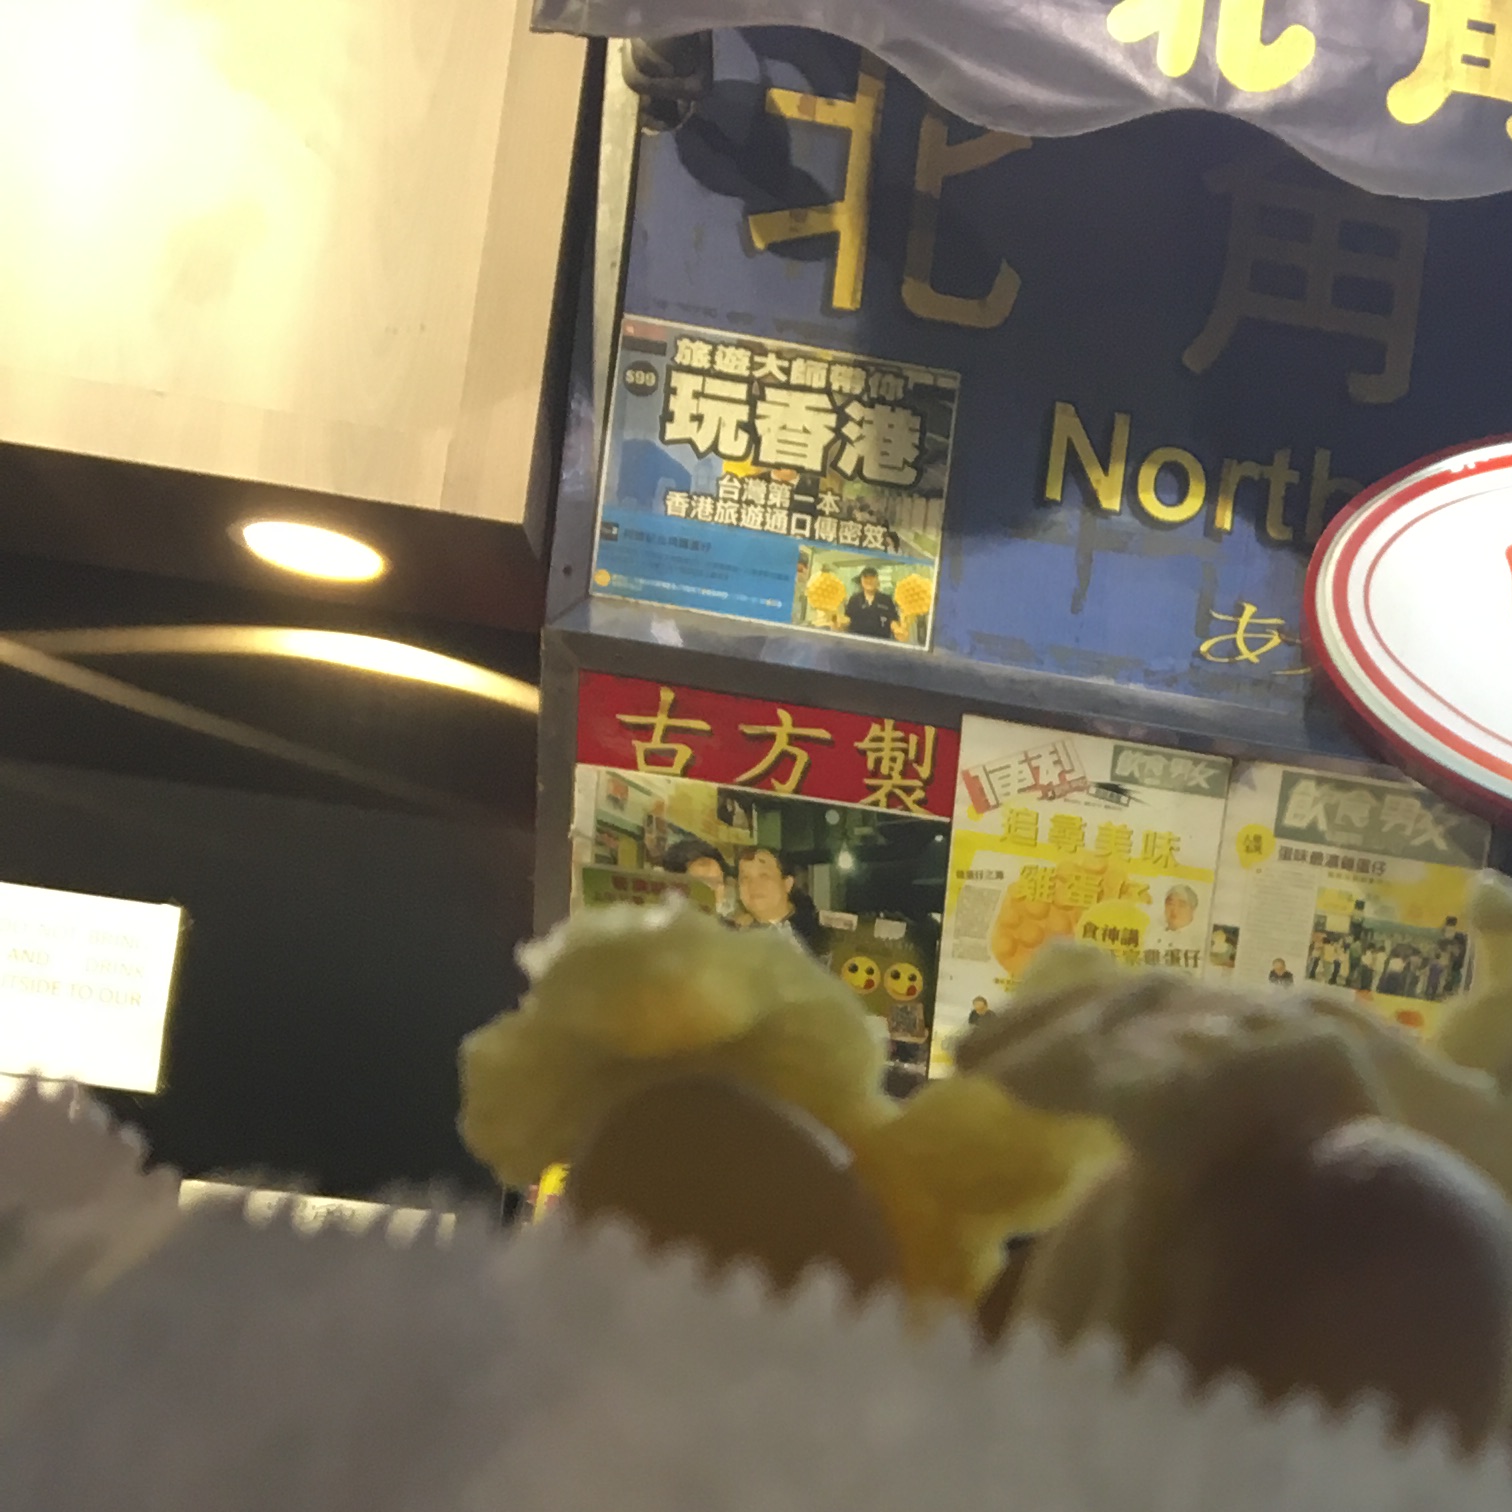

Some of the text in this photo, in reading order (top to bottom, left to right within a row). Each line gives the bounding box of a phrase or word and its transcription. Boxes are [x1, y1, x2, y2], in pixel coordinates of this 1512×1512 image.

[664, 369, 922, 486] 玩香港
[718, 475, 840, 515] 台灣第一本
[616, 686, 940, 817] 古方製
[1001, 806, 1181, 868] 追尋美味
[1283, 778, 1461, 851] 飲食男女
